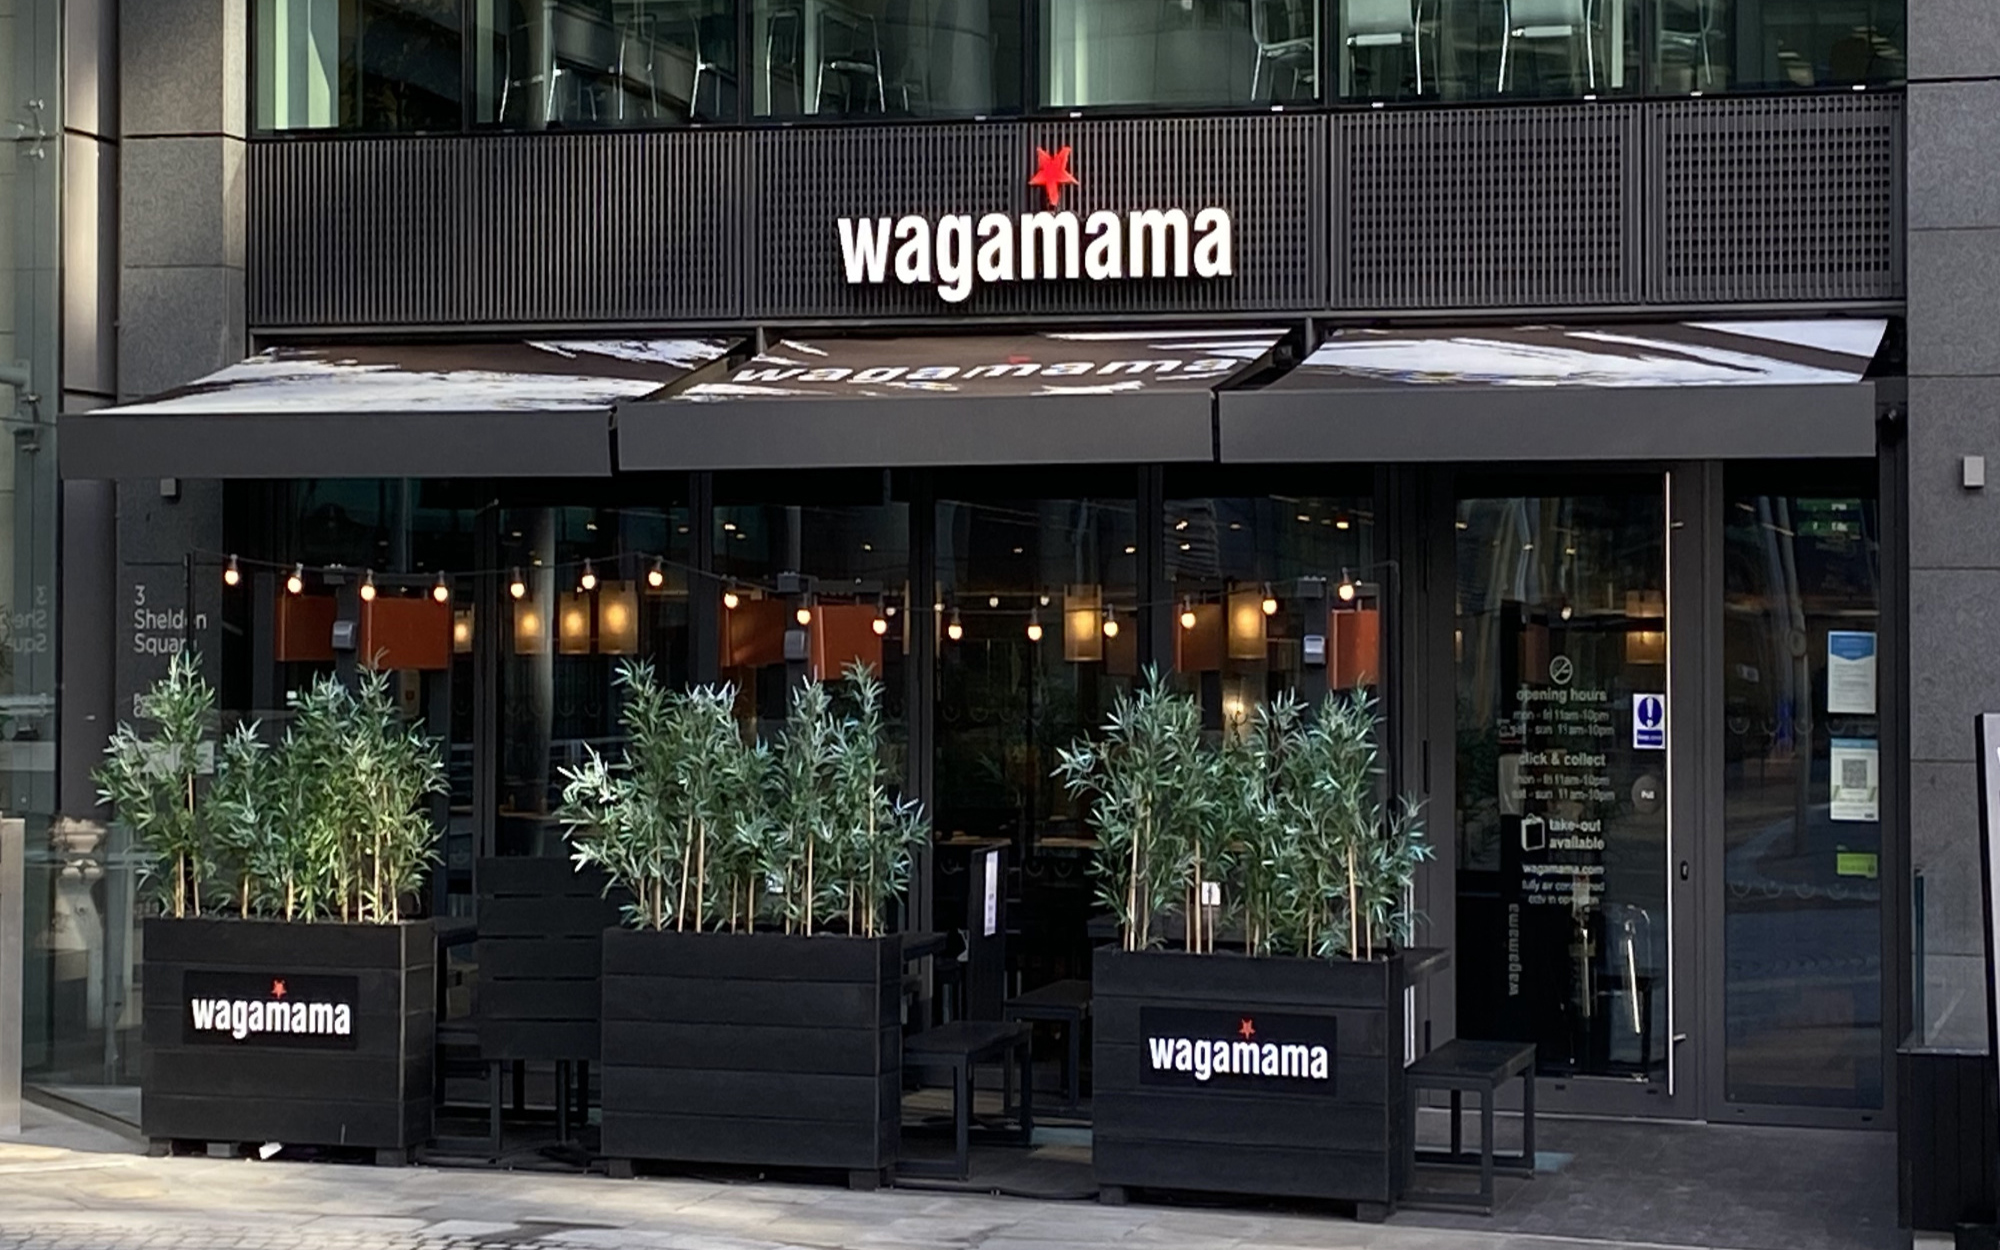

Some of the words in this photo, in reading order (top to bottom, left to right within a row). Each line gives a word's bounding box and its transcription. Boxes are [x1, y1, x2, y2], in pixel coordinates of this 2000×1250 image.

[837, 206, 1232, 303] wagamama
[731, 358, 1239, 383] wagamama
[134, 585, 145, 606] 3
[134, 633, 197, 657] Squar
[1516, 687, 1567, 704] opening
[1570, 688, 1607, 701] hours
[1519, 752, 1547, 766] click
[1551, 752, 1560, 766] &
[1564, 752, 1606, 766] collect
[1549, 819, 1601, 833] take-out
[1549, 835, 1604, 850] available
[1522, 864, 1605, 876] wagamama.com
[1509, 903, 1522, 996] wagamama
[192, 998, 350, 1040] wagamama
[1149, 1037, 1328, 1081] wagamama
